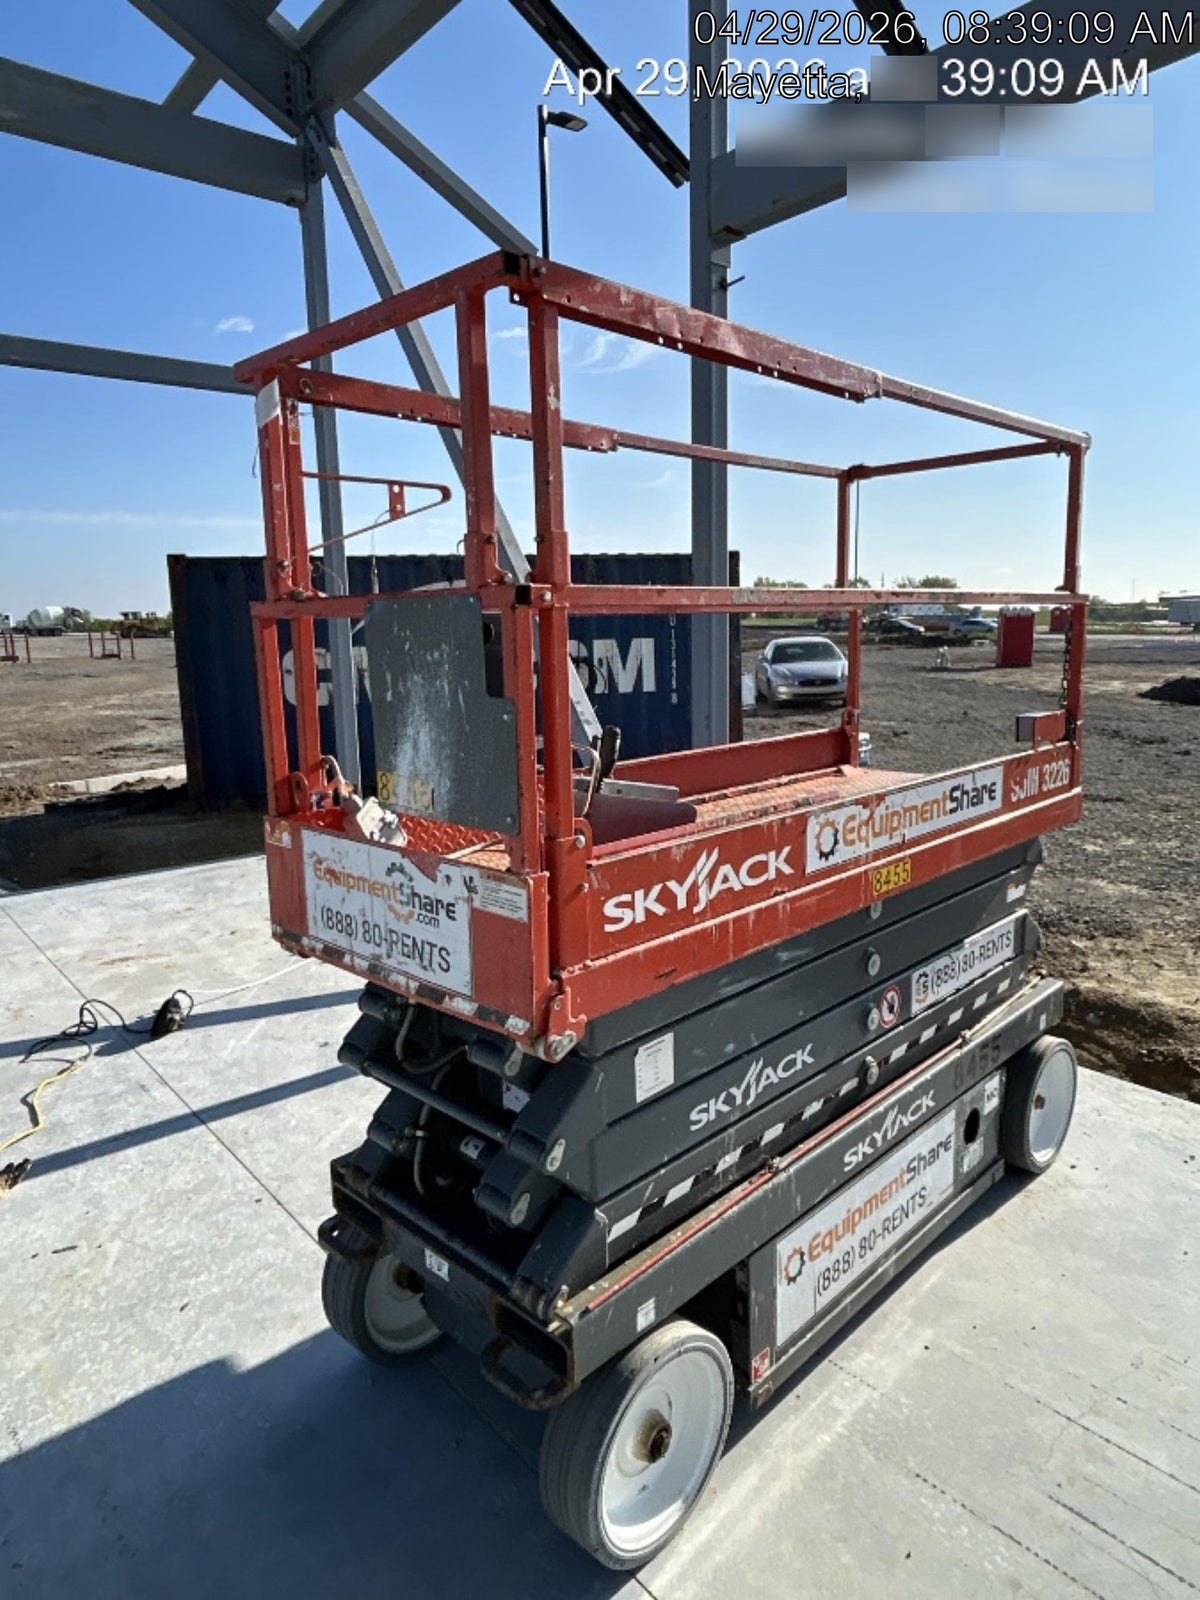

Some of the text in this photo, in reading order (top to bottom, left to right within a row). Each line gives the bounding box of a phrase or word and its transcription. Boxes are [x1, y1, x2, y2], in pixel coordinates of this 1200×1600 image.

[1042, 758, 1071, 792] 3226
[841, 779, 999, 845] EquipmentShare
[312, 862, 457, 922] EquipmentShare
[602, 845, 794, 934] SKYJACK
[874, 861, 909, 893] 8455
[320, 904, 452, 974] (888) 80-RENTS
[962, 929, 1013, 974] 80-RENTS
[689, 1042, 816, 1132] SKYJACK
[843, 1089, 936, 1173] SKYJACK
[807, 1132, 954, 1263] EquipmentShare
[815, 1186, 929, 1297] (888) 80-RENTS
